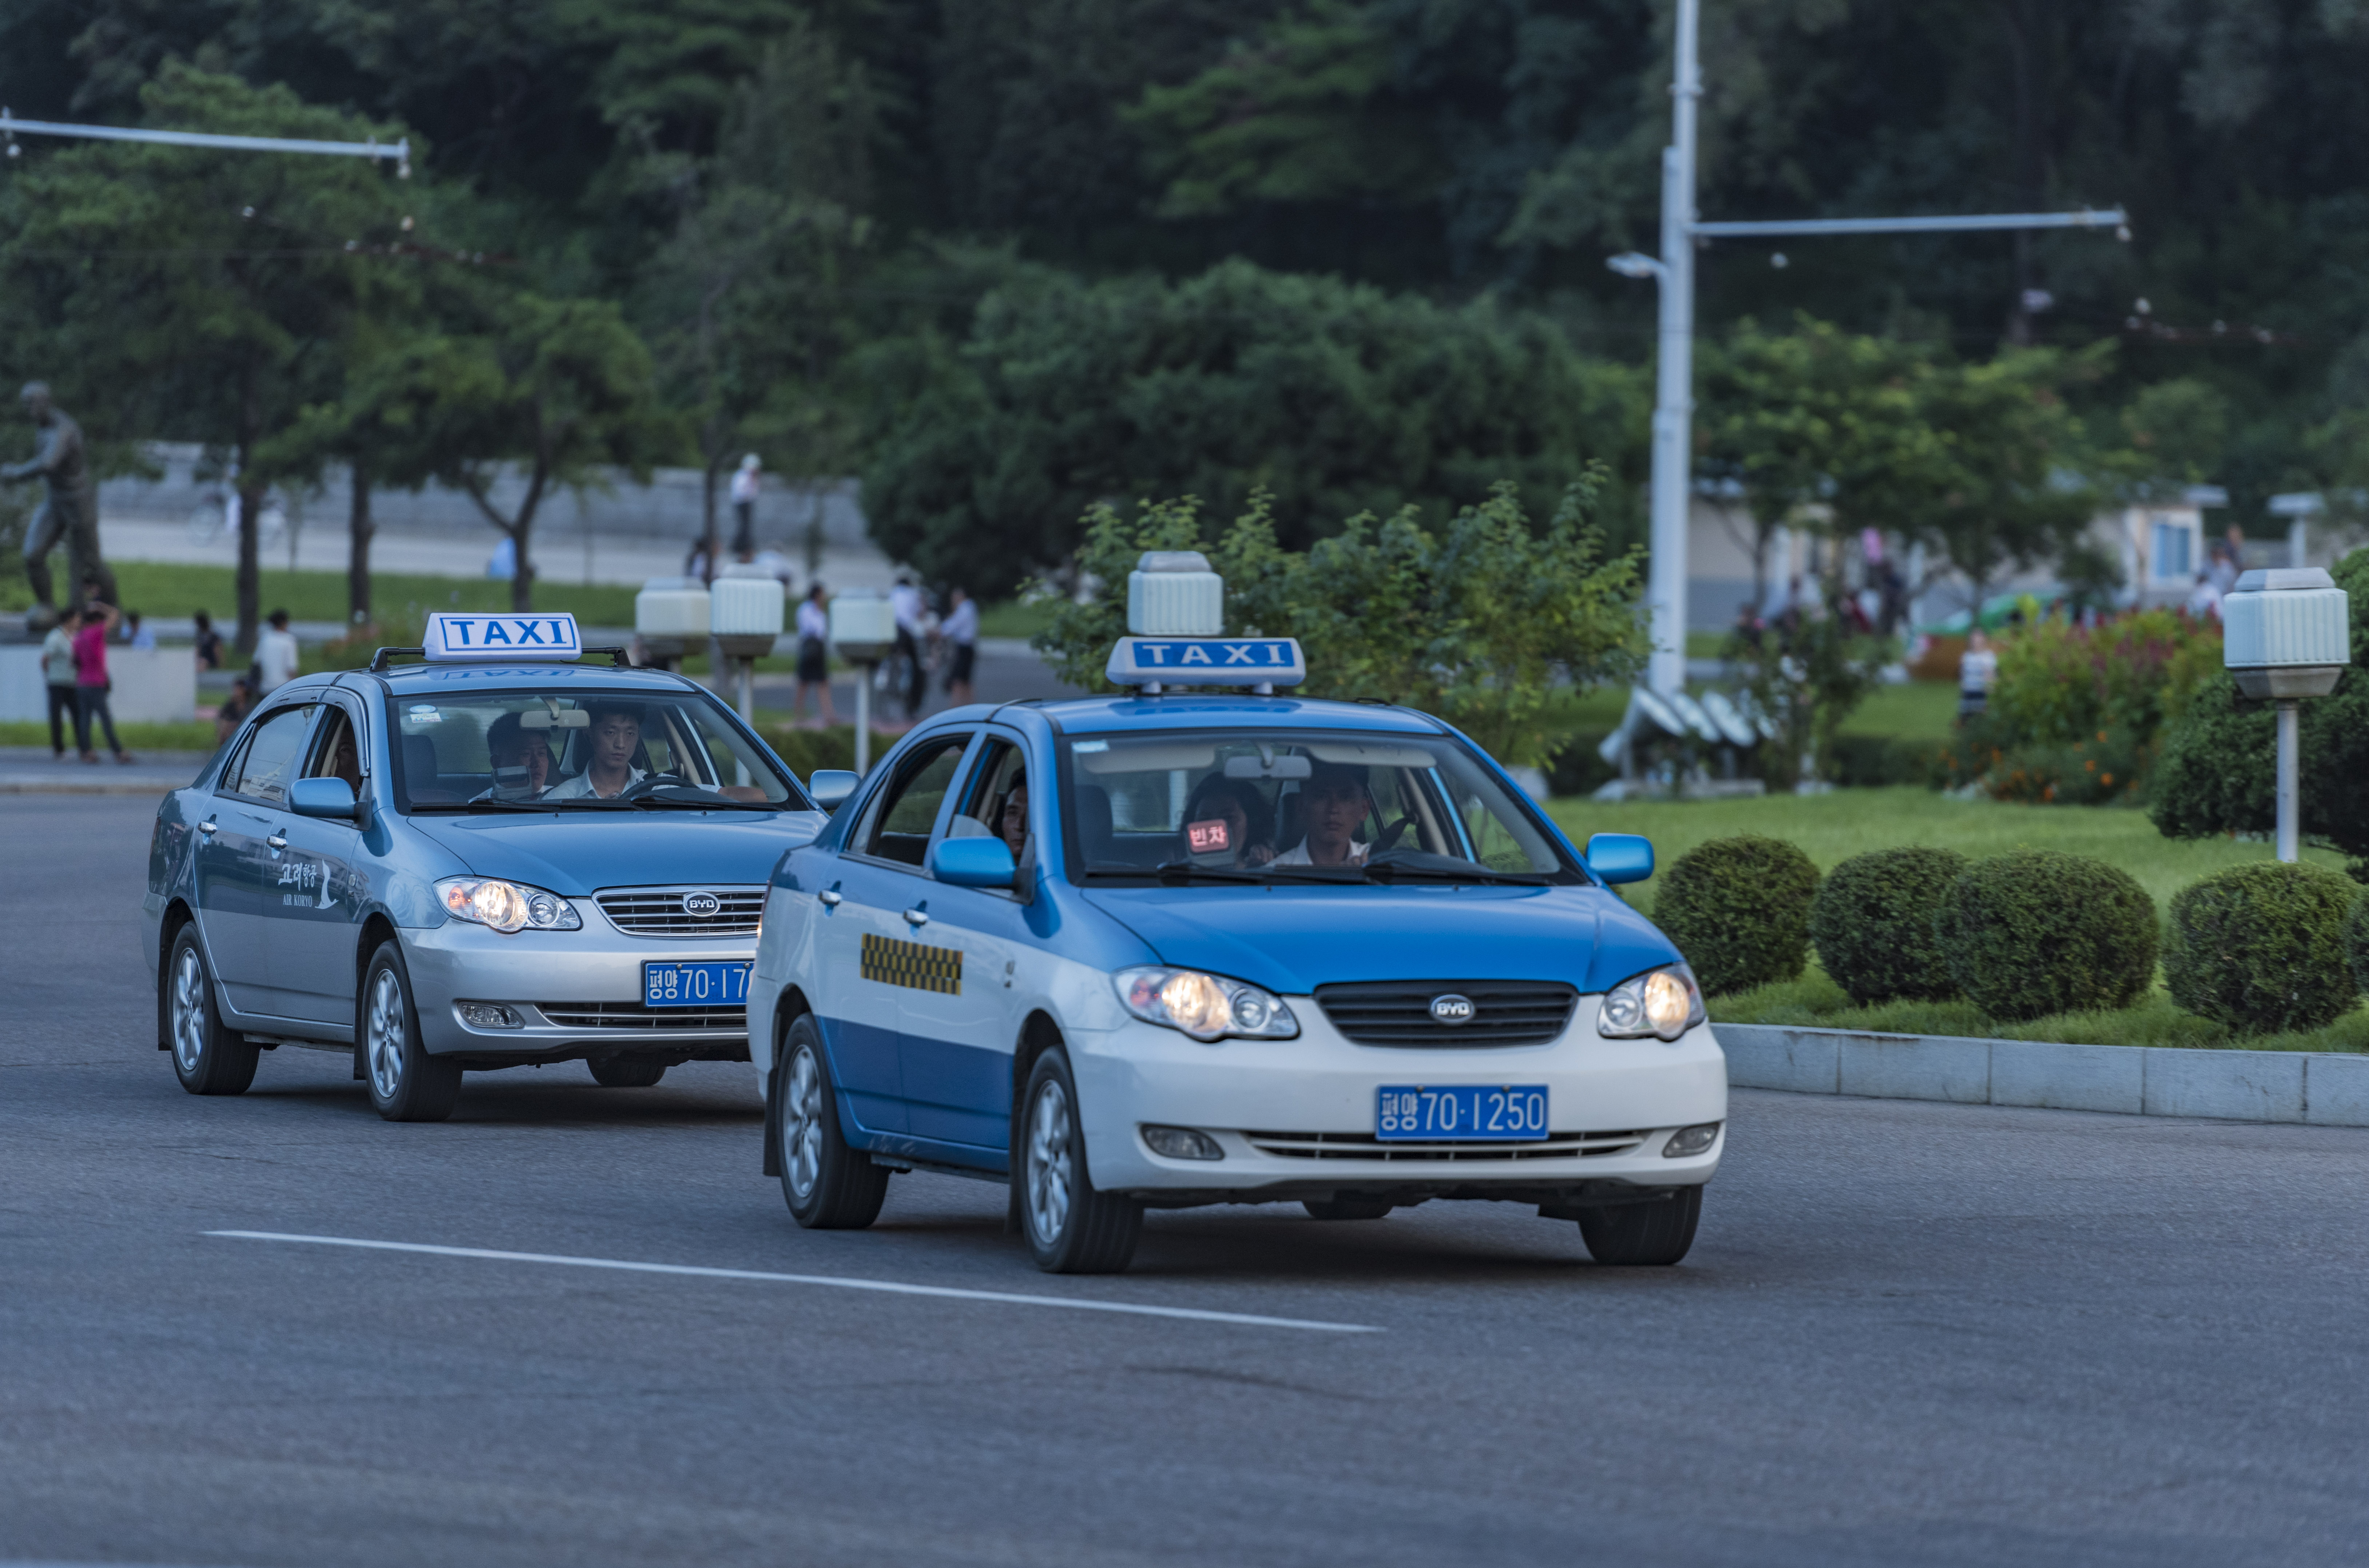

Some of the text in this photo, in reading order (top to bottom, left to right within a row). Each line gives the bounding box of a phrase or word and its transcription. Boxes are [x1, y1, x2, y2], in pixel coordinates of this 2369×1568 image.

[450, 621, 567, 645] TAXI
[1142, 644, 1286, 664] TAXI
[1190, 825, 1226, 847] 빈차
[278, 862, 317, 891] 고려항공
[283, 894, 313, 907] AIR KORYO
[689, 900, 715, 908] BYD
[1436, 1002, 1469, 1016] BYD
